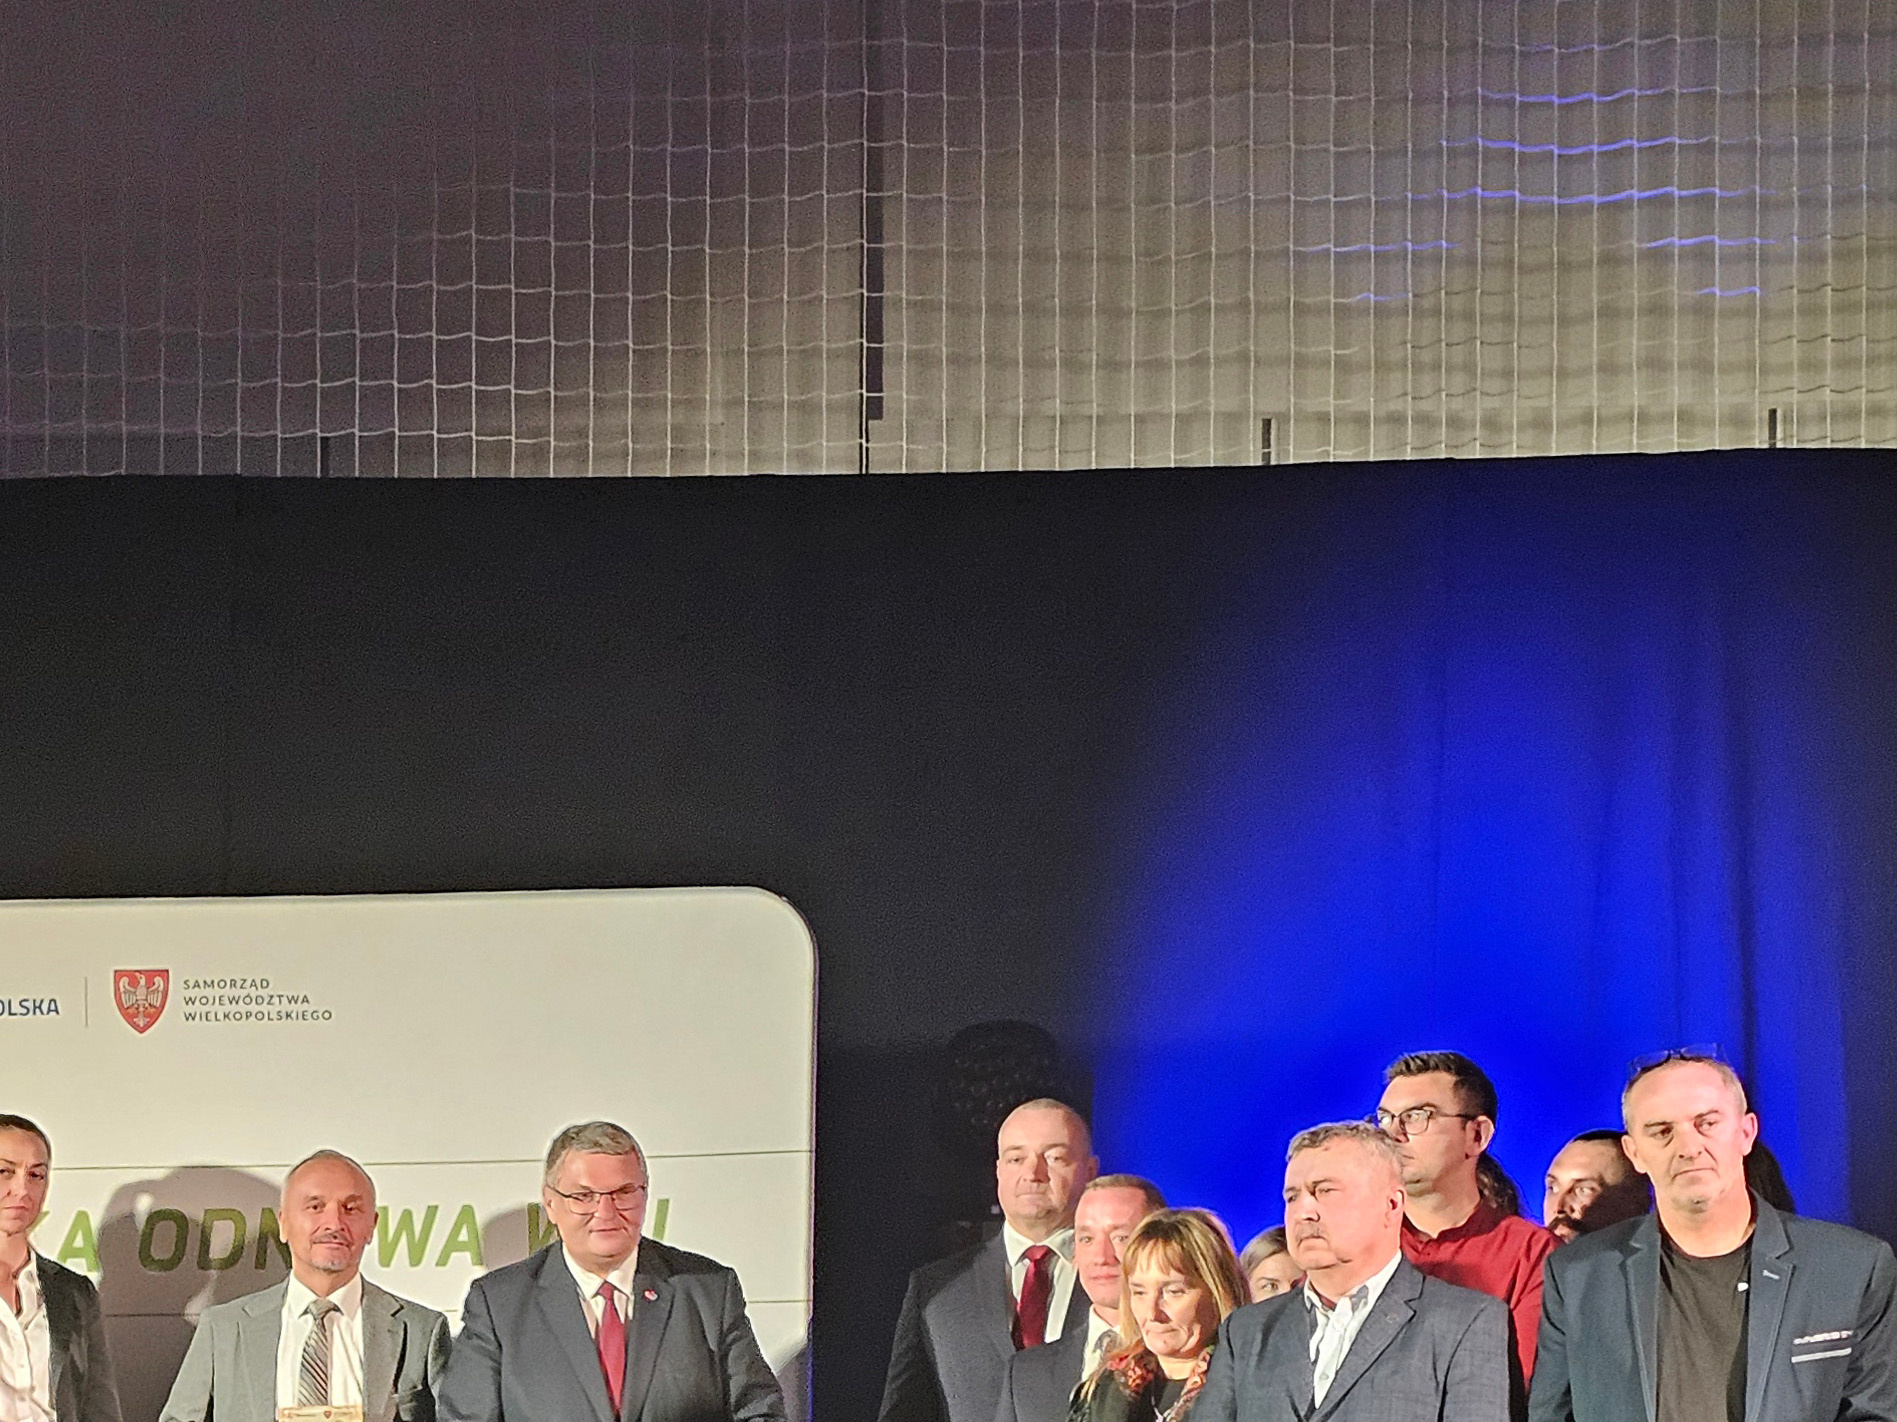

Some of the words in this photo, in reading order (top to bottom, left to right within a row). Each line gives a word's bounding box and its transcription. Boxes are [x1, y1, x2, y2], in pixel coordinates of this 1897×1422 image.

[183, 978, 270, 991] SAMORZĄD
[183, 993, 310, 1006] WOJEWÓDZTWA
[183, 1010, 332, 1022] WIELKOPOLSKIEGO
[138, 1204, 484, 1273] ODNWA
